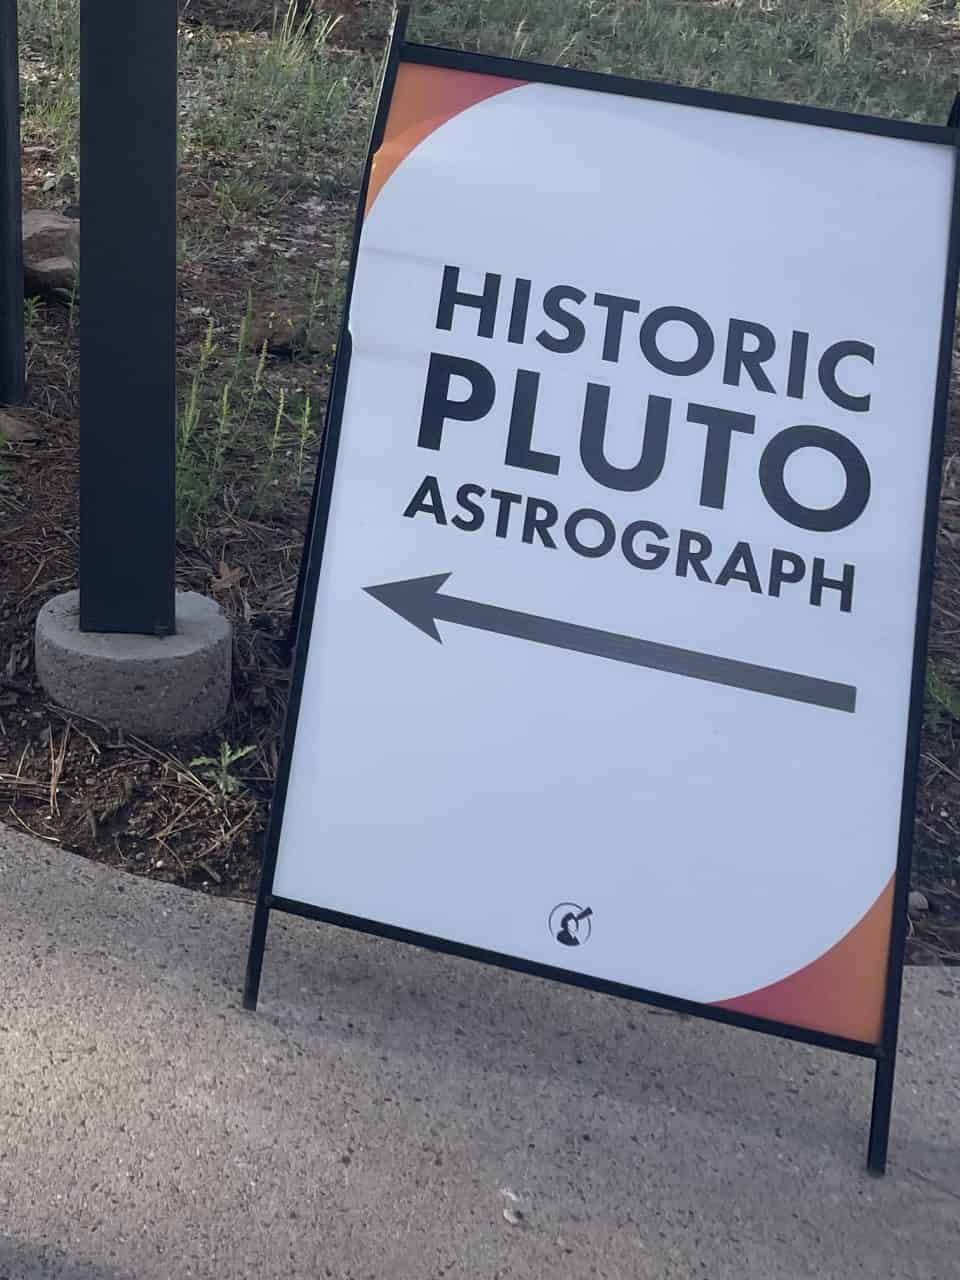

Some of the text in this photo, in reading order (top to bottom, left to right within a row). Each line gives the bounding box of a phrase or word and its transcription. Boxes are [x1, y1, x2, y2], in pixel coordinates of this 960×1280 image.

[436, 265, 874, 412] HISTORIC
[417, 352, 871, 532] PLUTO
[403, 475, 855, 613] ASTROGRAPH
